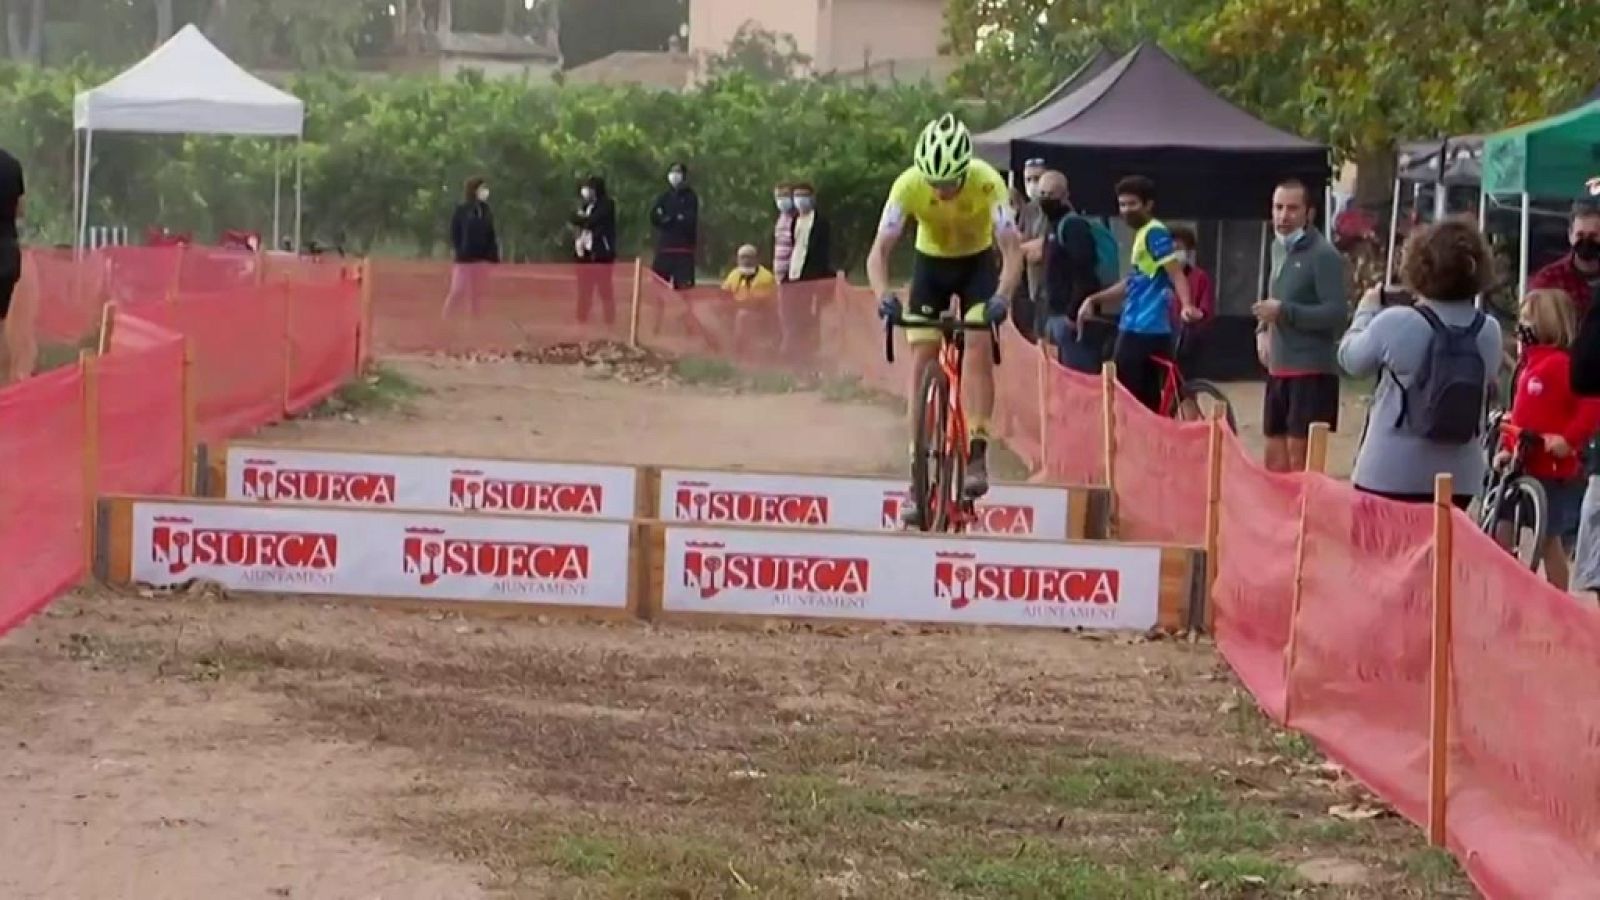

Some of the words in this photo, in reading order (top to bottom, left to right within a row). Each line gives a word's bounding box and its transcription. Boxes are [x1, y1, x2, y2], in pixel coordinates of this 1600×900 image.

[278, 472, 392, 504] SUECA
[485, 482, 598, 514] SUECA
[711, 492, 825, 525] SUECA
[195, 531, 335, 571] SUECA
[446, 541, 586, 581] SUECA
[241, 570, 336, 585] AJUNTAMENT
[492, 581, 587, 596] AJUNTAMENT
[726, 556, 866, 594] SUECA
[976, 566, 1116, 605] SUECA
[772, 593, 867, 609] AJUNTAMENT
[1023, 605, 1118, 620] AJUNTAMENT
